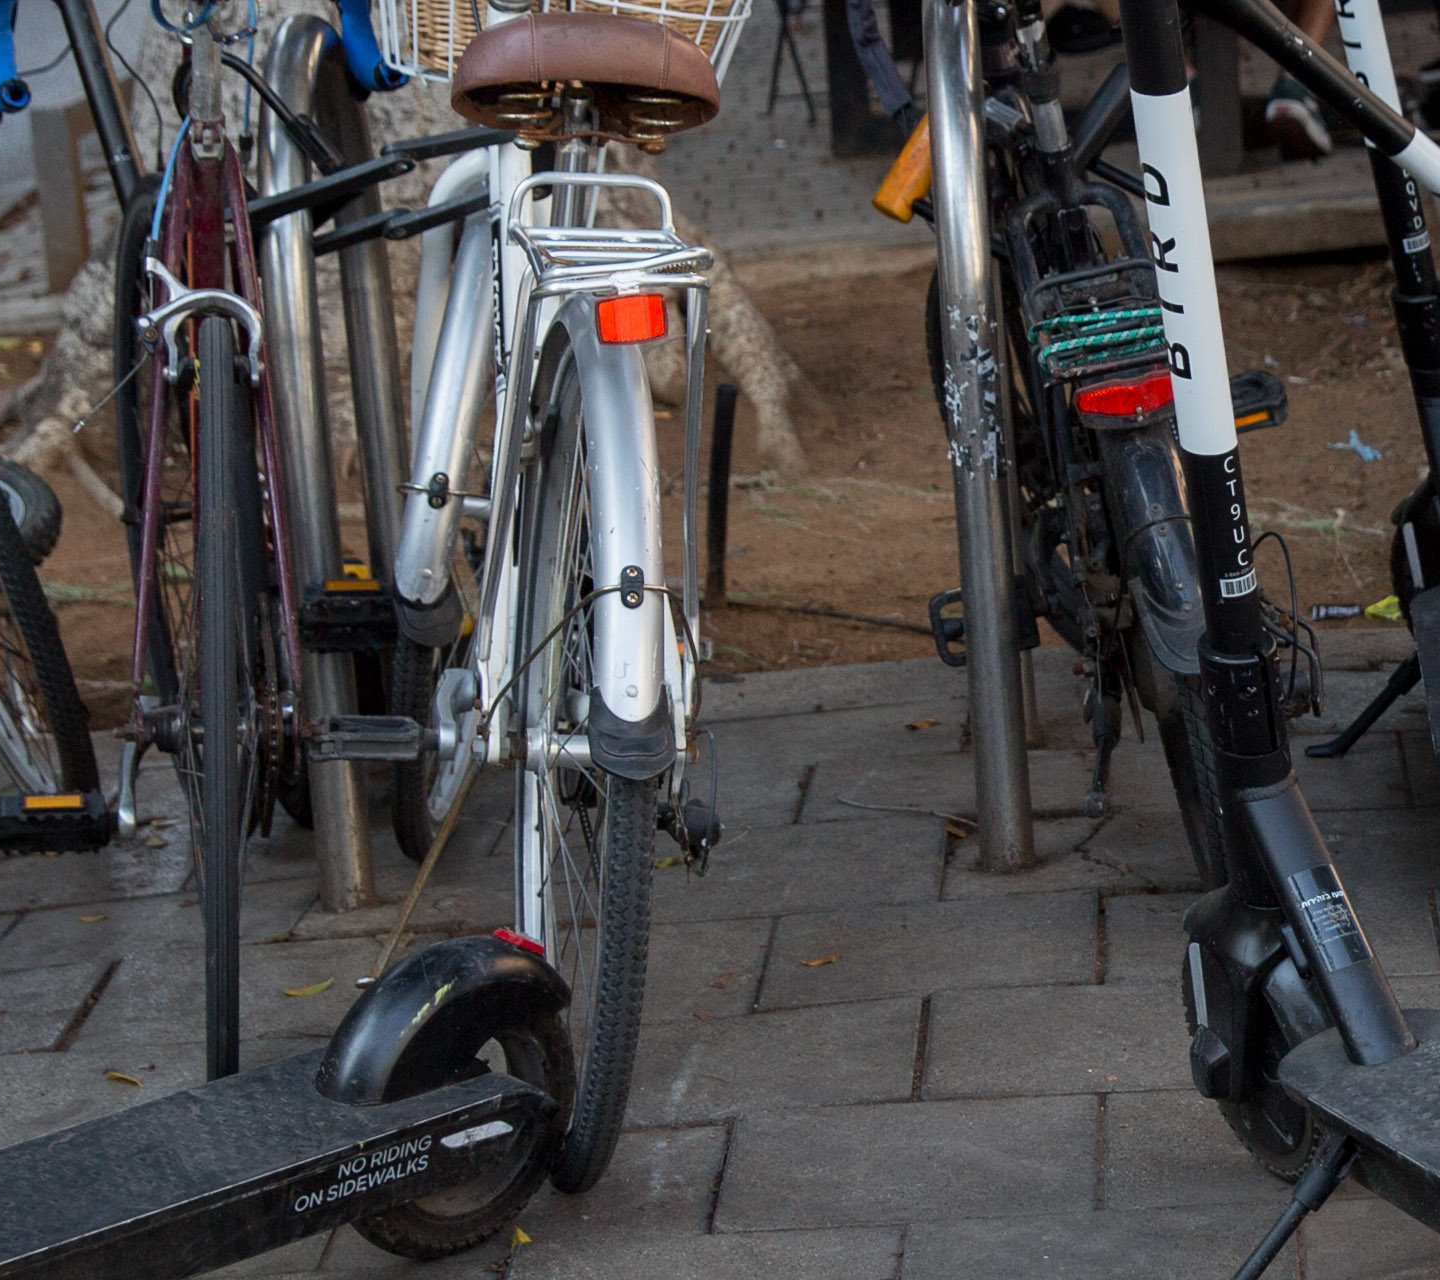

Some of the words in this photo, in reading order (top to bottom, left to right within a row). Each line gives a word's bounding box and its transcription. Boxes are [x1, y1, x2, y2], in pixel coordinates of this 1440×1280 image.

[1142, 162, 1193, 380] BIRD
[1223, 456, 1249, 566] CT9UC
[294, 1189, 324, 1212] ON
[326, 1155, 430, 1202] SIDEWALKS
[337, 1157, 367, 1179] NO
[370, 1135, 433, 1169] RIDING
